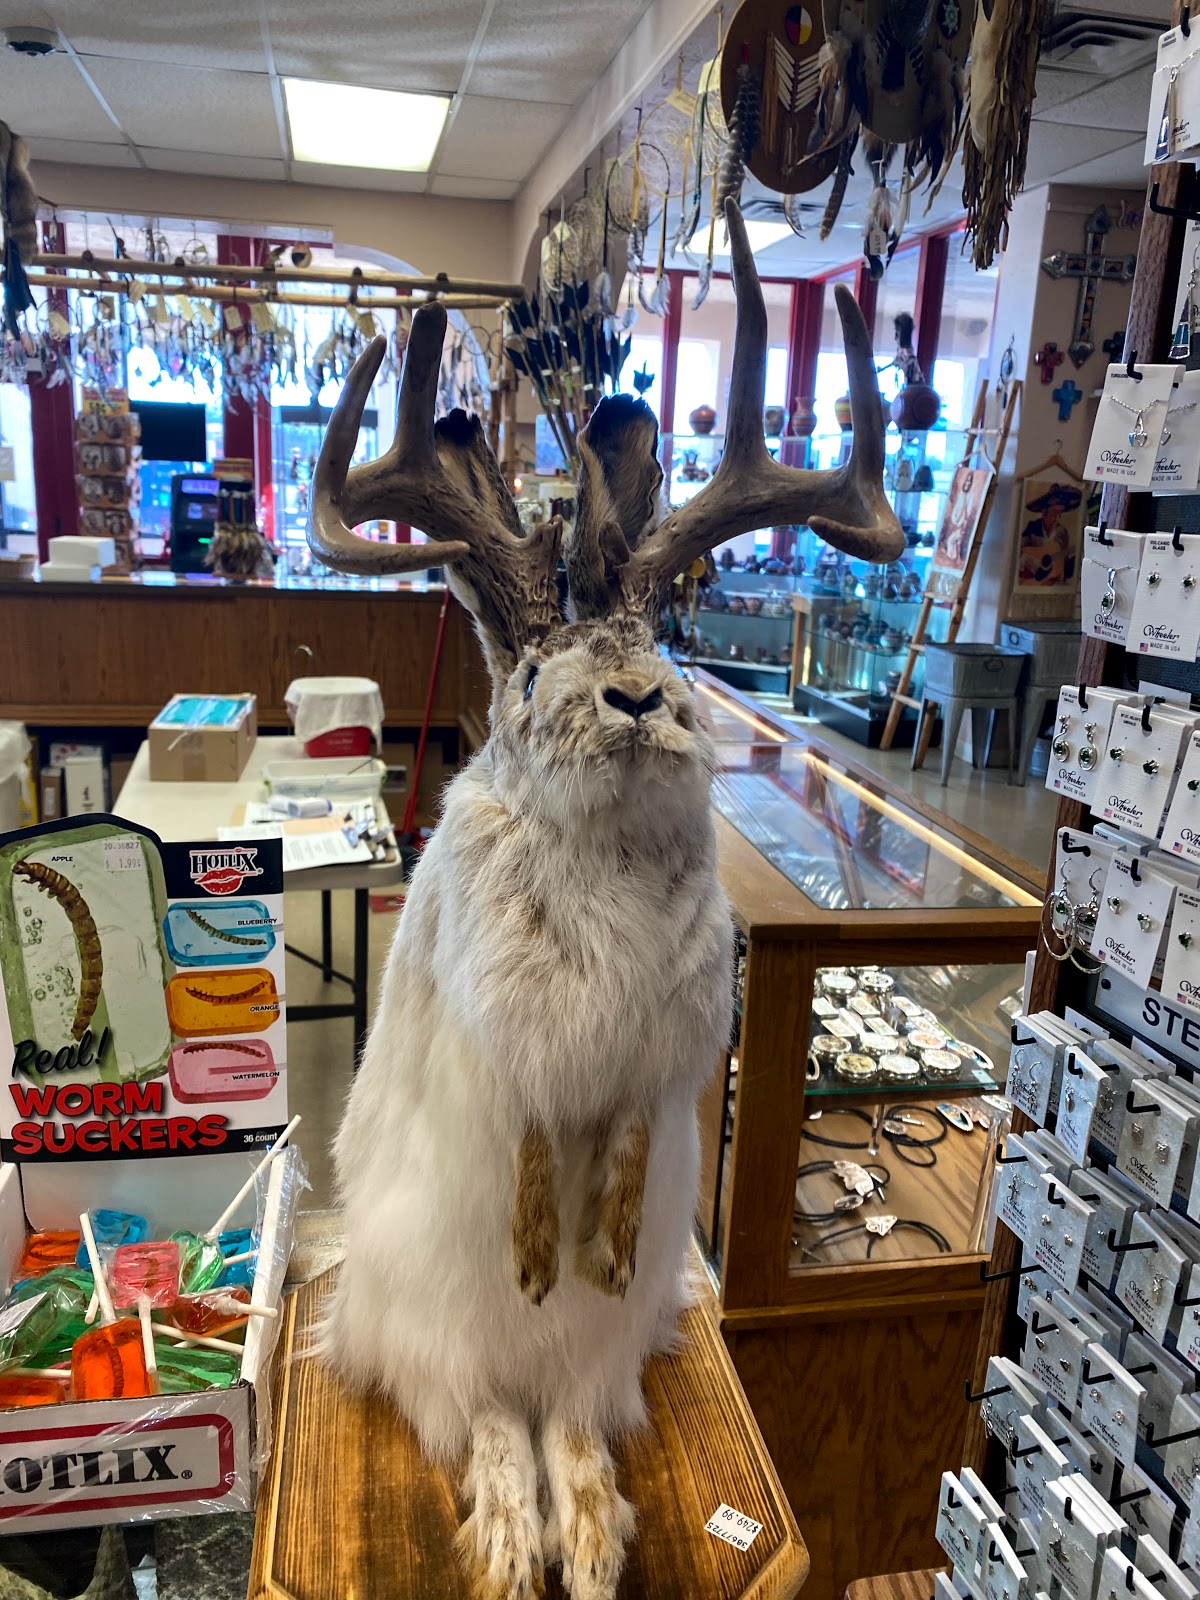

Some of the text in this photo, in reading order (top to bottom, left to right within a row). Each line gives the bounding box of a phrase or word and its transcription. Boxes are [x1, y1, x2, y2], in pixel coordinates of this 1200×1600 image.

[1100, 450, 1136, 467] Wheeler
[1154, 457, 1181, 473] heeler
[1143, 624, 1180, 642] Wheeler
[1059, 768, 1086, 788] Wheeler
[1108, 796, 1142, 818] Wheeler
[1113, 813, 1126, 822] MADE
[190, 852, 258, 876] HOTLIX
[238, 918, 277, 926] BLUEBERRY
[1105, 937, 1135, 965] Wheeler
[1110, 955, 1121, 965] MADE
[1127, 966, 1135, 975] USA
[12, 1027, 109, 1077] Real!
[232, 1071, 280, 1080] WATERMELON
[8, 1082, 163, 1118] WORM
[12, 1114, 229, 1154] SUCKERS
[244, 1132, 277, 1142] 36 count
[1130, 1156, 1157, 1186] Wheeler
[1040, 1238, 1064, 1266] Wheeler
[1037, 1358, 1064, 1386] Wheeler
[1093, 1416, 1120, 1447] Wheeler
[0, 1444, 179, 1495] OTLIX
[722, 1509, 758, 1534] $249.99
[707, 1522, 748, 1548] 38677725
